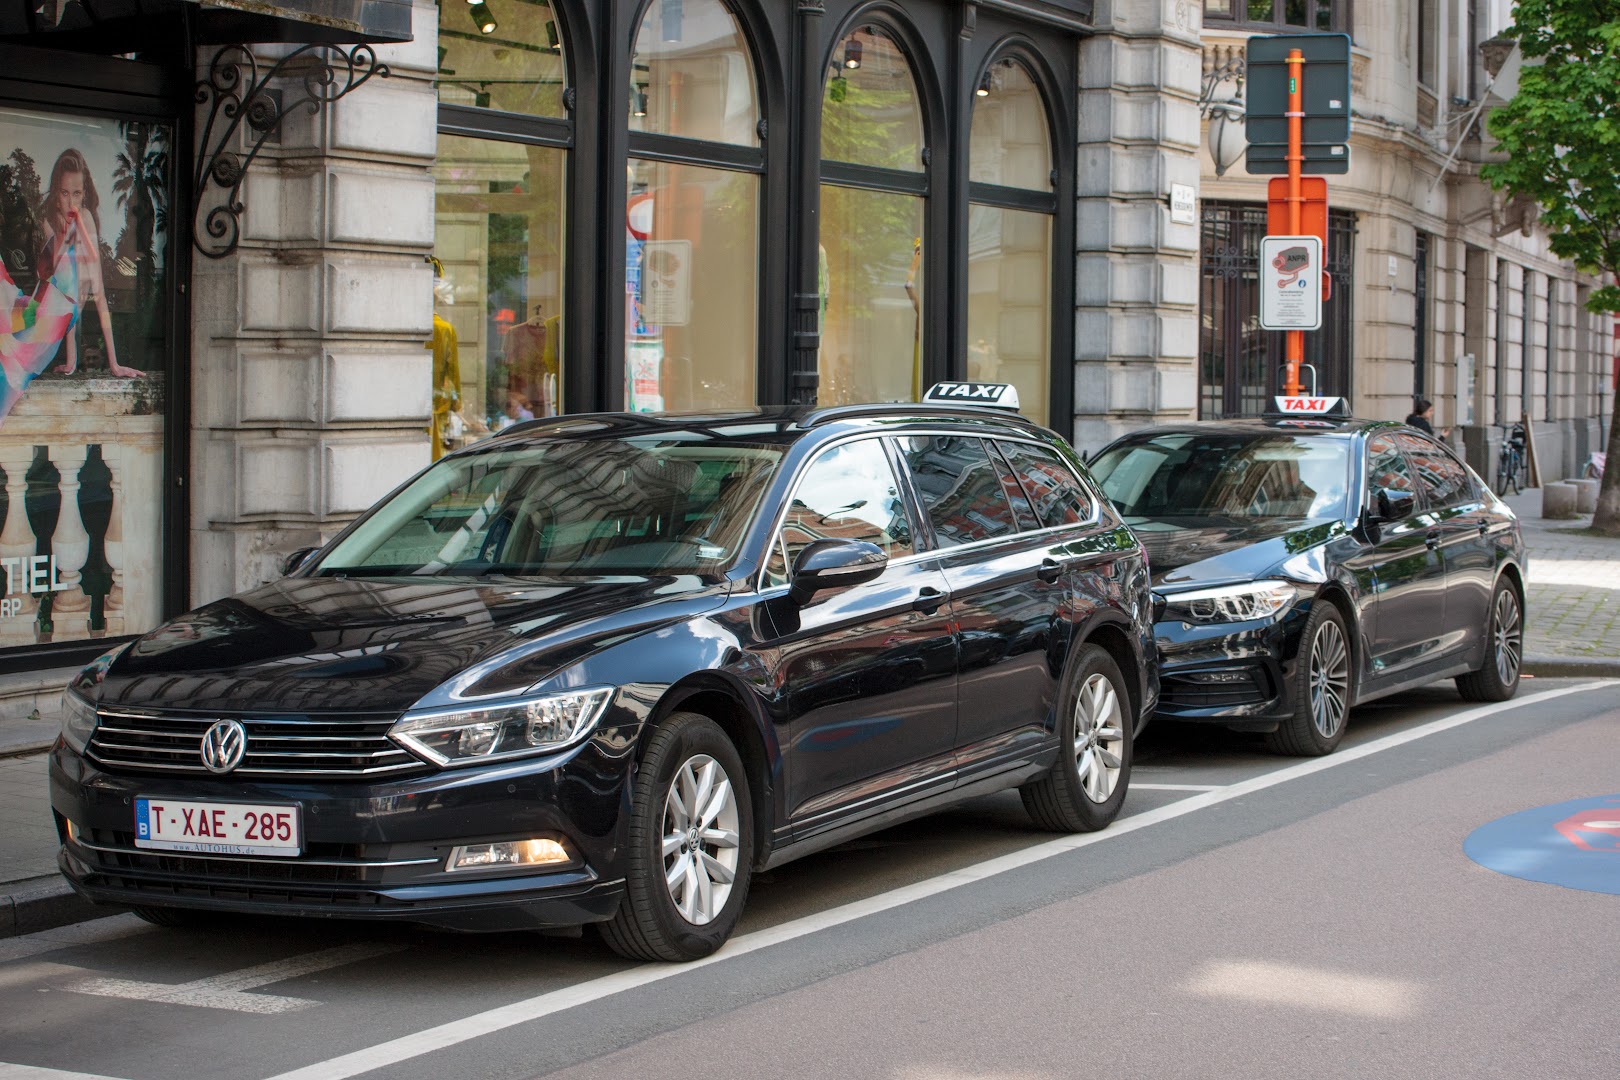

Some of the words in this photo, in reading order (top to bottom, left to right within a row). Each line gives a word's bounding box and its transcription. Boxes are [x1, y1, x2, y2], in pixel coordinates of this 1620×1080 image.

[1287, 254, 1306, 262] ANPR
[938, 383, 1005, 399] TAXI
[1284, 399, 1326, 411] TAXI
[0, 554, 68, 595] TIEL
[139, 822, 148, 836] B
[173, 843, 255, 855] www.AUTOHUS.de
